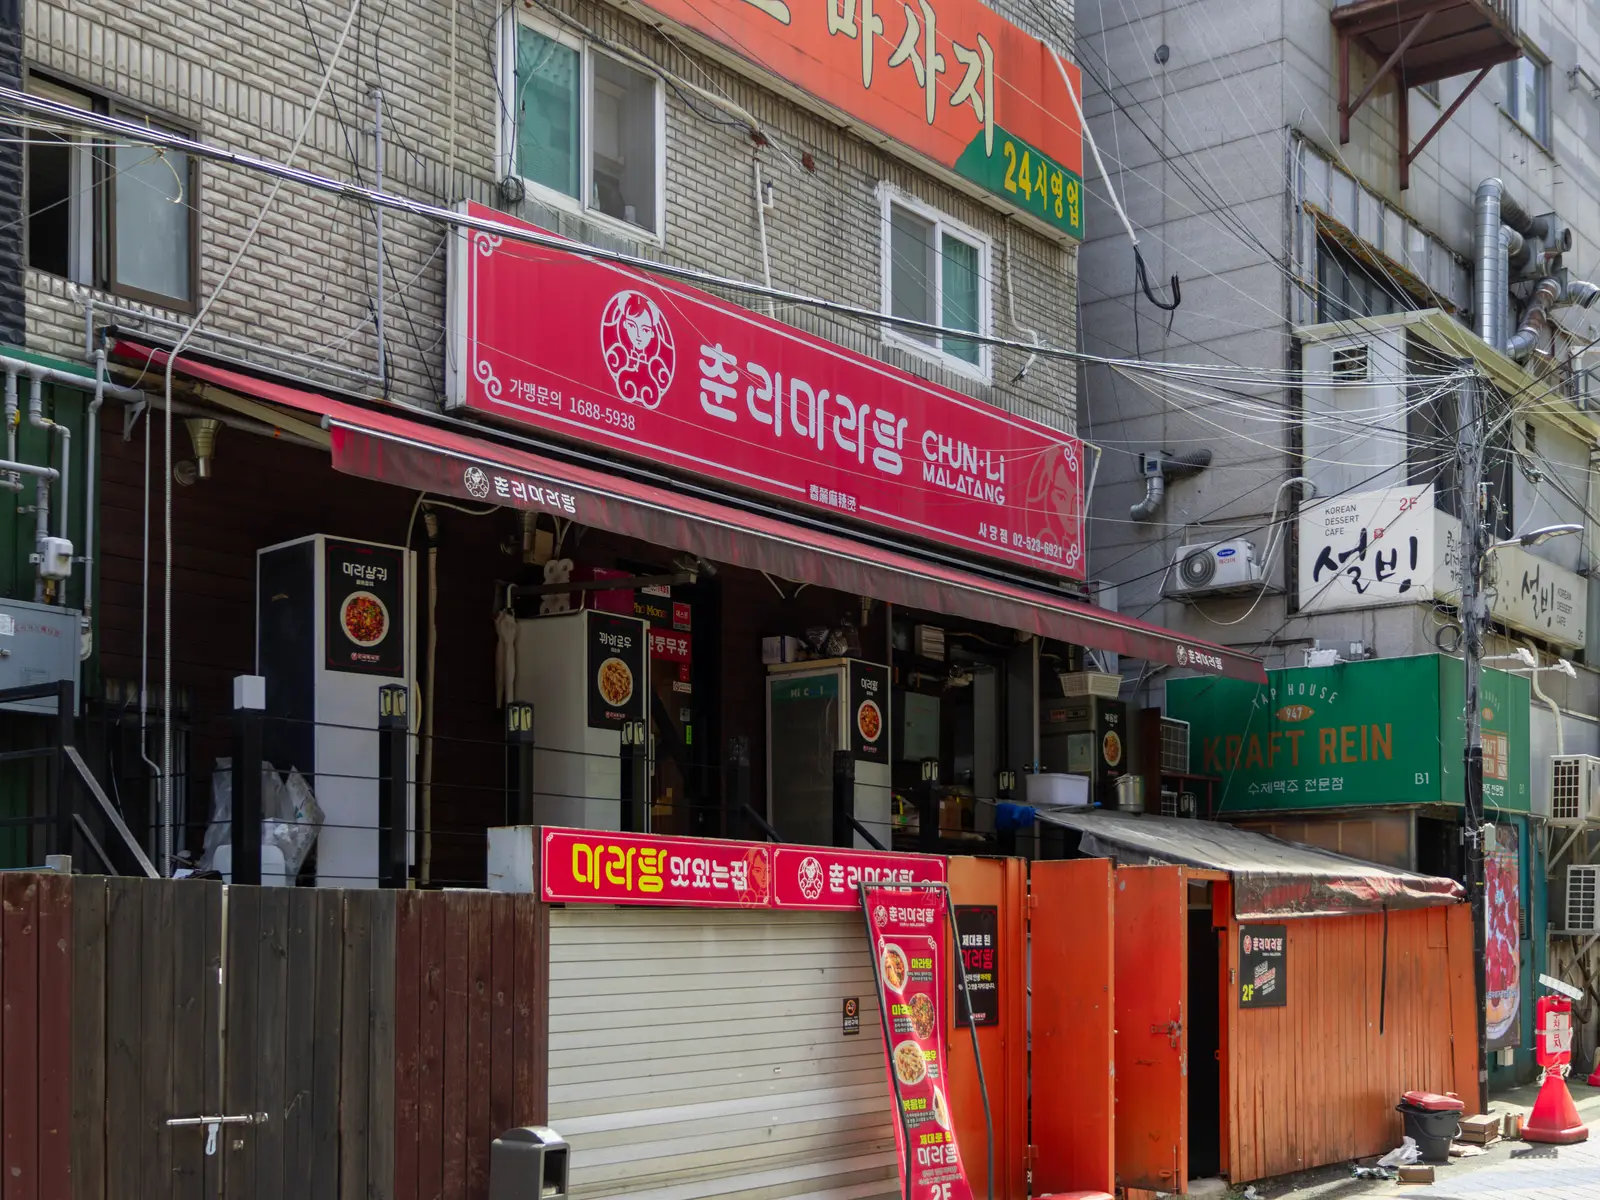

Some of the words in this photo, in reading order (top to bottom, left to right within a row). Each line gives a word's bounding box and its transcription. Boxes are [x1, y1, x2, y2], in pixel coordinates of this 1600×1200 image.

[827, 0, 996, 158] 마사지
[509, 378, 562, 411] 가맹문의
[569, 397, 636, 431] 1688-5938
[699, 343, 908, 476] 춘리마라탕
[494, 476, 576, 514] 춘리마라탕
[922, 464, 1005, 506] MALATANG
[1325, 504, 1357, 515] KOREAN
[1399, 497, 1417, 511] 2F
[1325, 515, 1360, 526] DESSERT
[1325, 527, 1344, 536] CAFE
[1012, 532, 1062, 559] 02-523-6921
[1313, 527, 1418, 594] 설빙
[1251, 688, 1277, 709] TAP
[1287, 683, 1338, 704] HOUSE
[1202, 729, 1306, 772] KRAFT
[1318, 723, 1393, 765] REIN
[1247, 780, 1300, 795] 수제맥주
[1304, 776, 1345, 793] 전문점
[1414, 772, 1430, 786] B1
[572, 843, 668, 893] 마라탕
[889, 906, 935, 923] 춘리마라탕
[911, 958, 933, 969] 마라탕
[1241, 983, 1254, 1001] 2F
